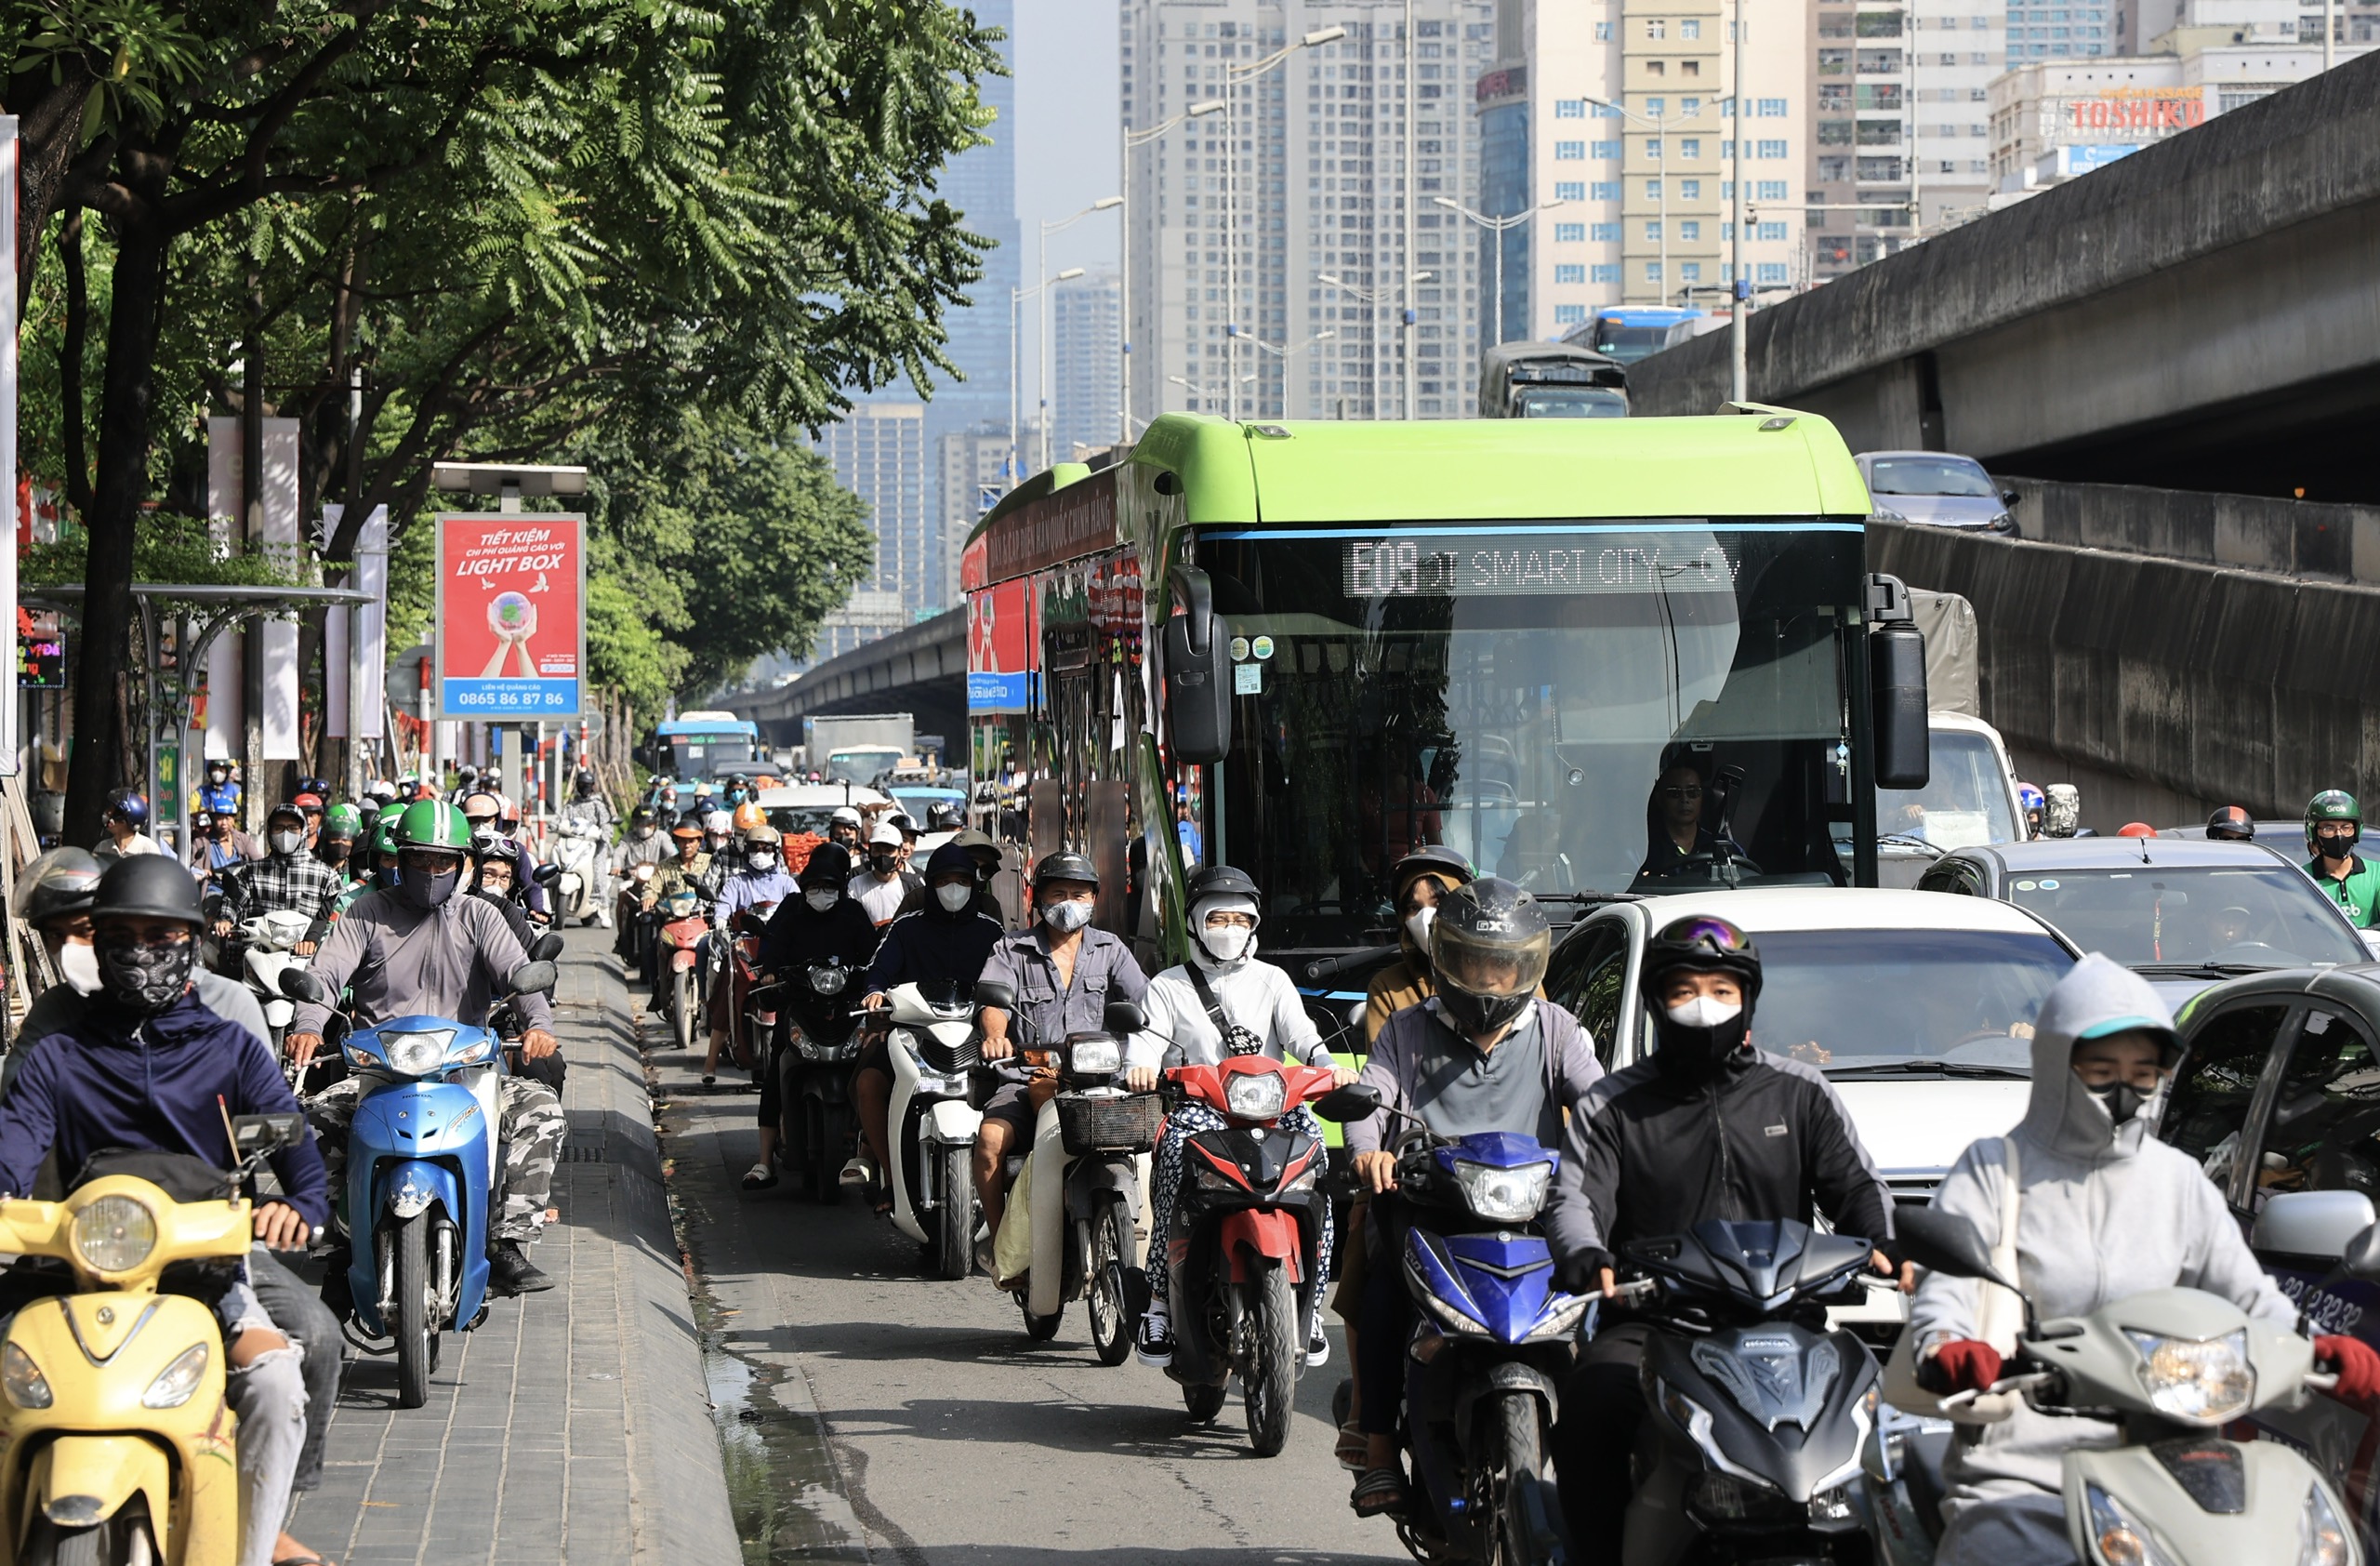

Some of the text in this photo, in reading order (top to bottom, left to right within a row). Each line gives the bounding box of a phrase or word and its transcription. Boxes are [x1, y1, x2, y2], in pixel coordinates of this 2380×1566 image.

[2069, 100, 2205, 128] TOSHIKO
[481, 527, 551, 546] TIẾT KIỆM
[466, 541, 565, 557] CHI PHÍ QUẢNG CÁO VỚI
[456, 553, 565, 577] LIGHT BOX
[1472, 549, 1585, 586] SMART
[1599, 548, 1659, 584] CITY
[496, 683, 505, 692] HỆ
[506, 683, 527, 691] QUẢNG
[458, 693, 563, 705] 0865 86 87 86
[2325, 804, 2347, 814] Grab
[1476, 920, 1515, 933] GXT
